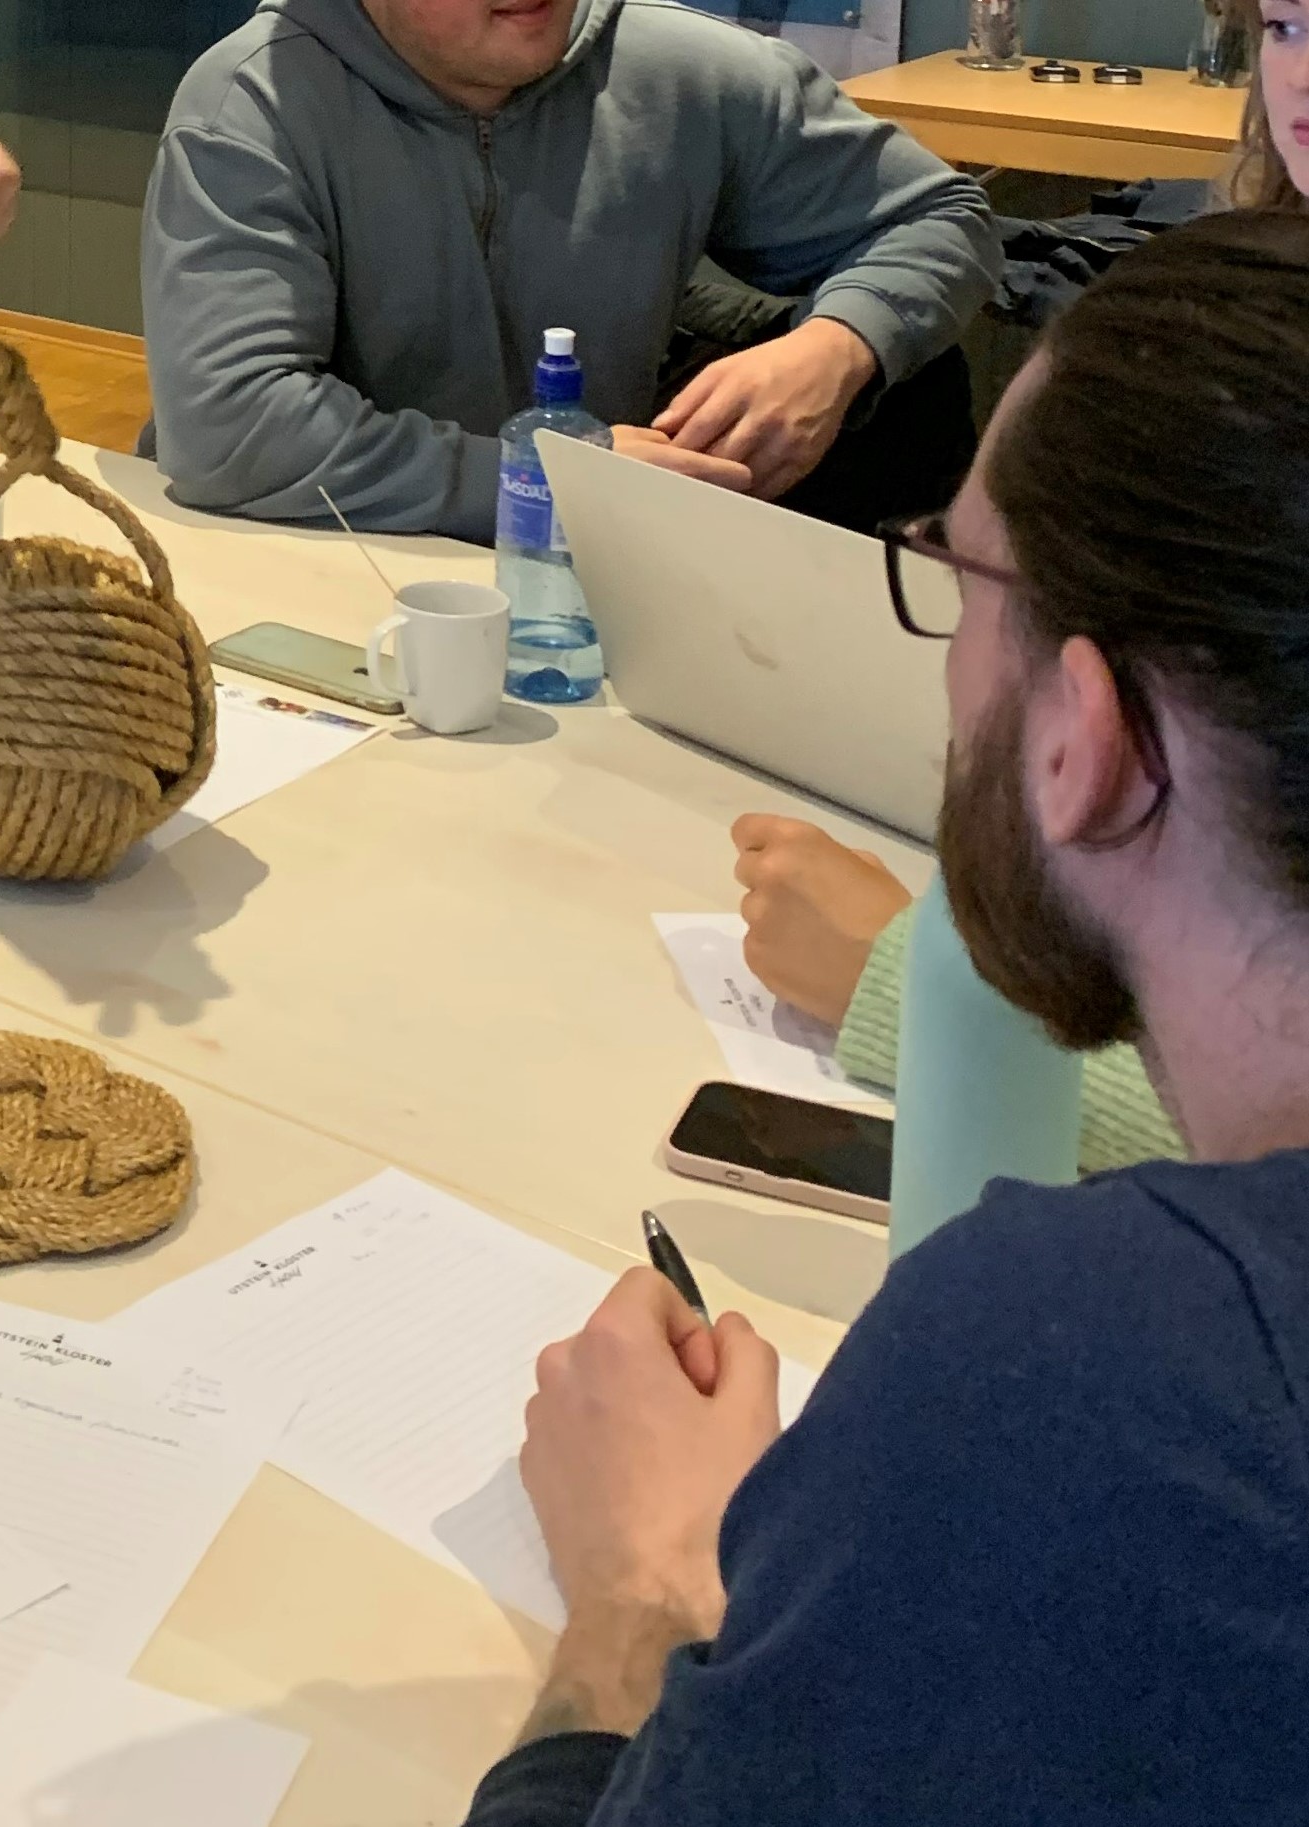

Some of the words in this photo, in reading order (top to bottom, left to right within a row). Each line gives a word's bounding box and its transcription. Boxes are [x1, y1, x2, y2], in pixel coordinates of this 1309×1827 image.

[228, 1270, 271, 1294] UTSTEIN
[274, 1246, 315, 1270] KLOSTER
[55, 1347, 112, 1367] KLOSTER
